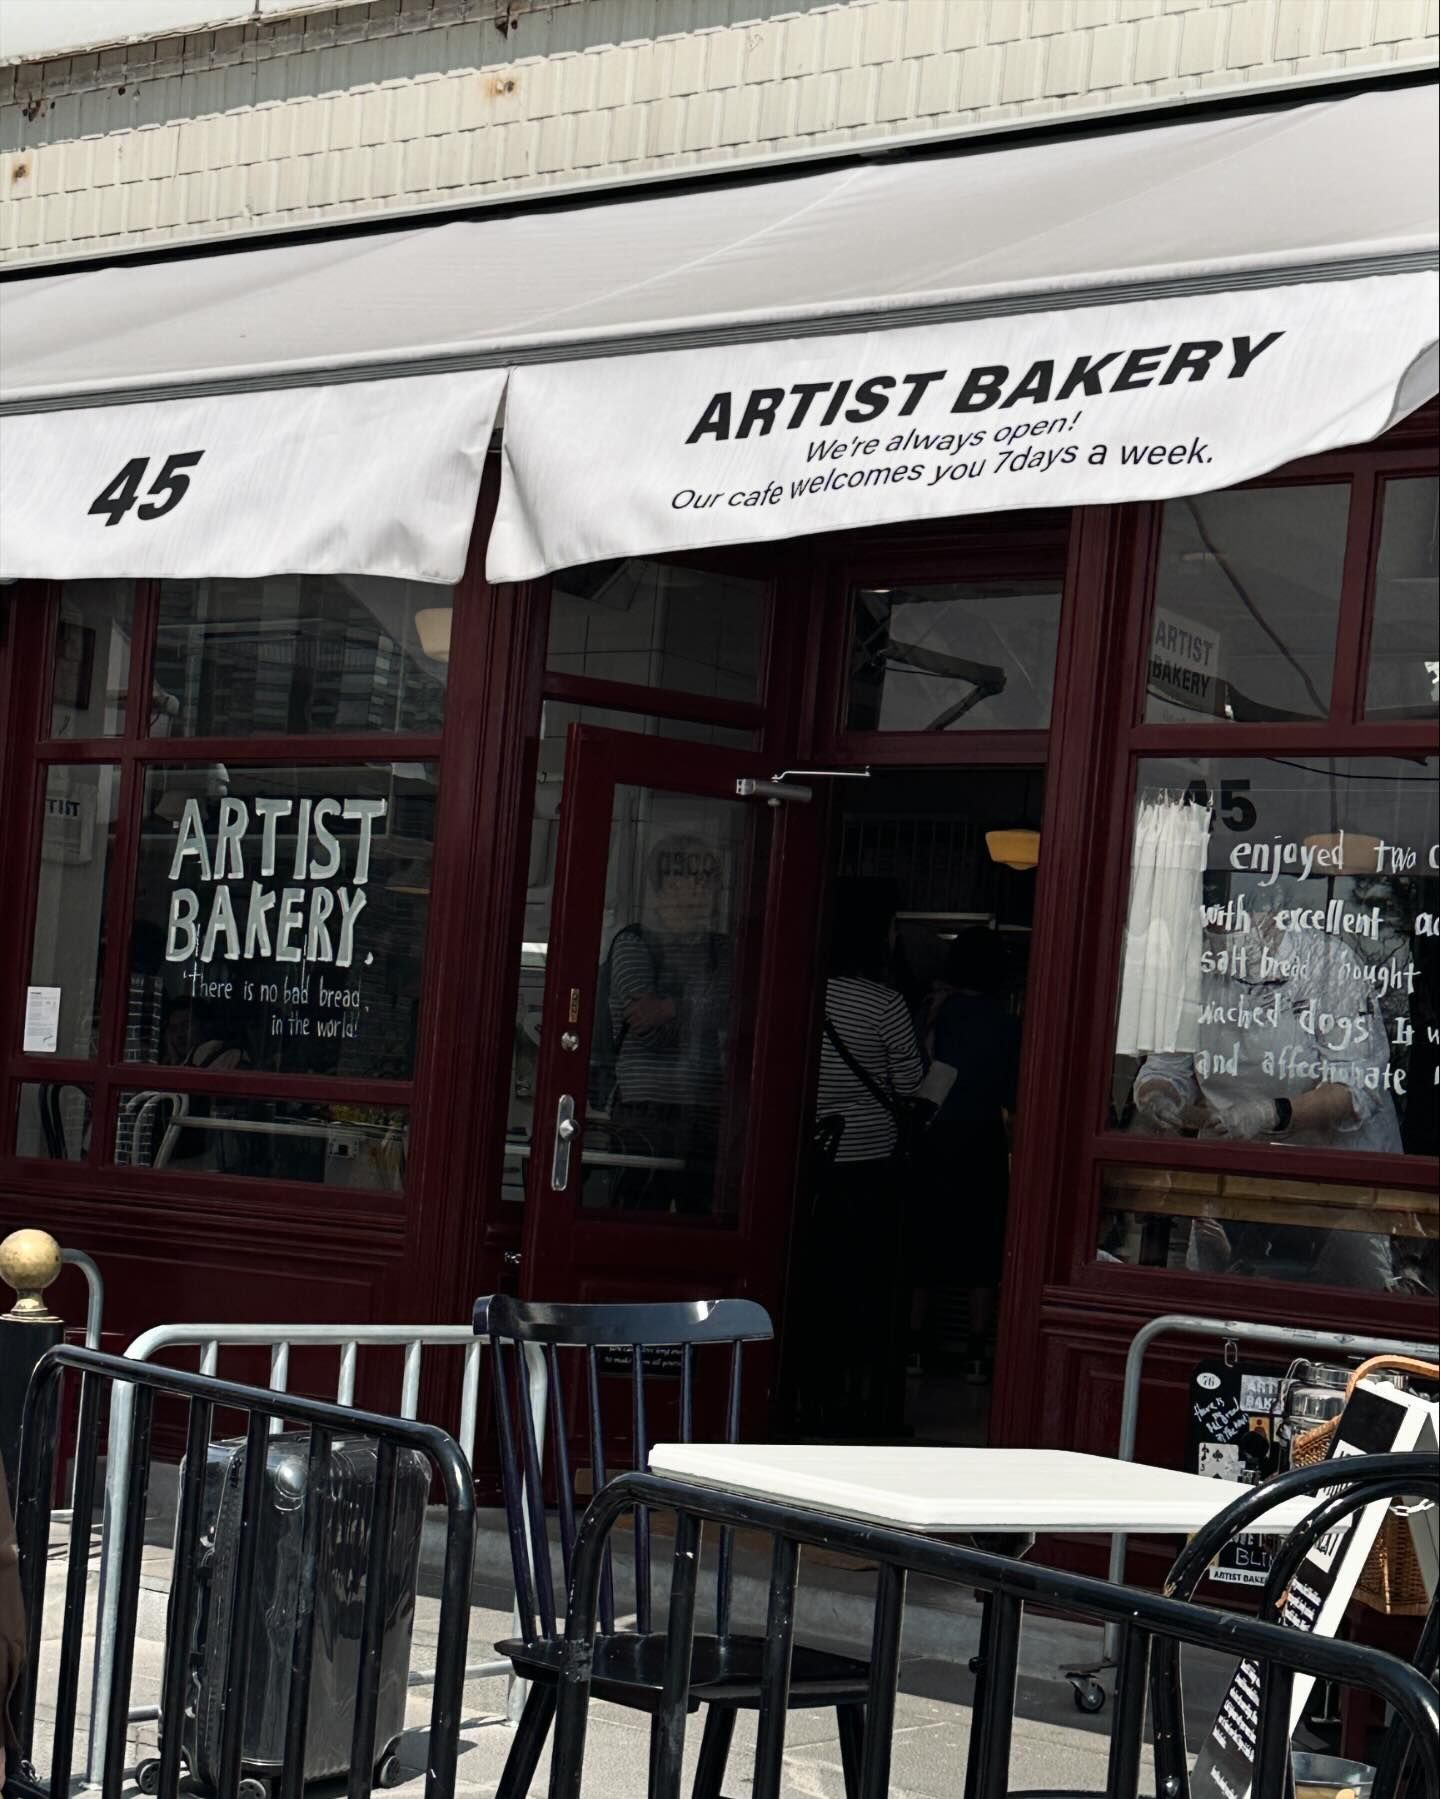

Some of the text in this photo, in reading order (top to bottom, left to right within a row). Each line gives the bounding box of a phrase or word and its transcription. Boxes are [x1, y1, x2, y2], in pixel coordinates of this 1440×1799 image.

[685, 332, 1284, 444] ARTIST BAKERY
[807, 411, 1081, 462] We're always open!
[88, 449, 206, 527] 45
[672, 436, 1213, 509] Our cafe welcomes you 7days a week.
[1154, 619, 1214, 667] ARTIST
[1151, 655, 1210, 698] BAKERY
[168, 797, 388, 885] ARTIST
[1230, 830, 1344, 887] enjoyed
[1374, 839, 1416, 874] two
[1273, 899, 1383, 940] excellent
[243, 981, 254, 1001] is
[260, 982, 278, 1003] no
[283, 975, 309, 1005] bad
[271, 1014, 283, 1036] in
[287, 1010, 310, 1036] the
[1298, 997, 1369, 1050] dogs
